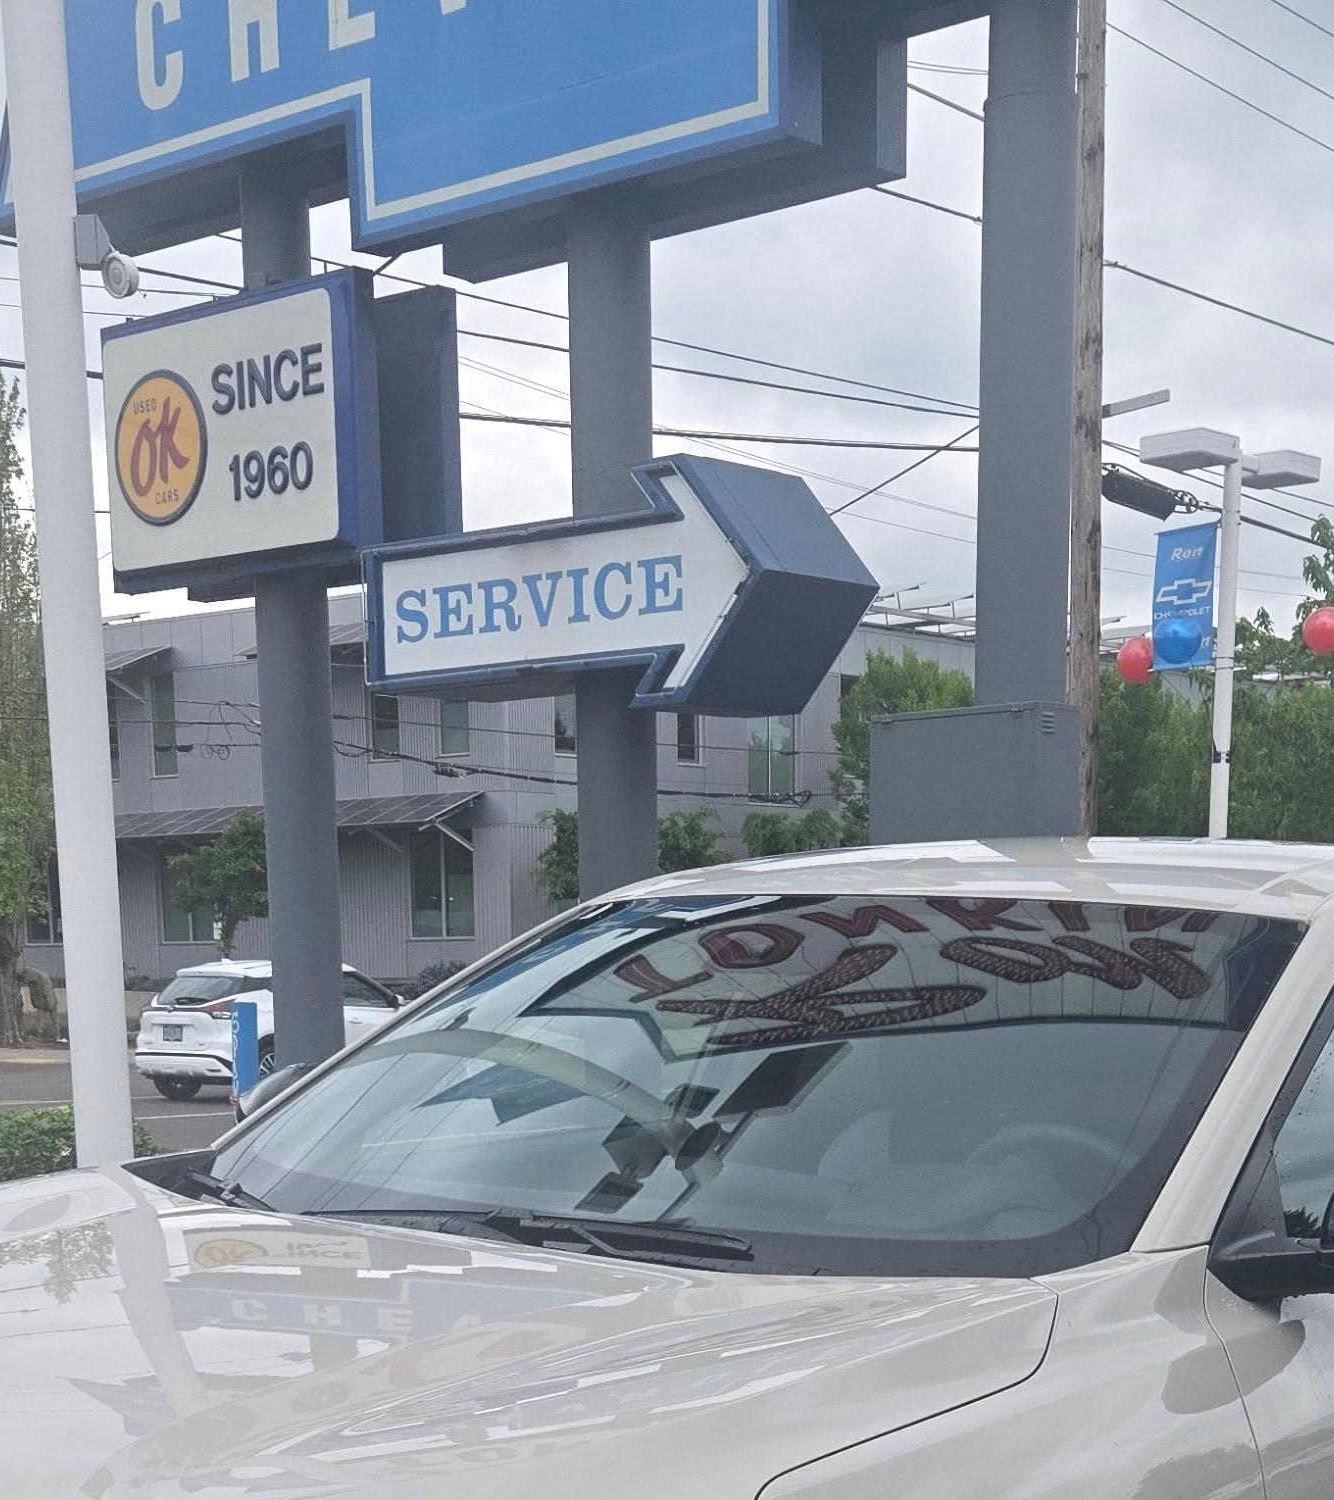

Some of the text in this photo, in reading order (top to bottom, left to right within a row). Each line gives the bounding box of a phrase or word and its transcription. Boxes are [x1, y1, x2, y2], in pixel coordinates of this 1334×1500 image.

[133, 398, 157, 415] USED
[210, 342, 325, 415] SINCE
[130, 396, 189, 497] OK
[228, 441, 313, 501] 1960
[155, 488, 180, 505] CARS
[395, 554, 684, 644] SERVICE
